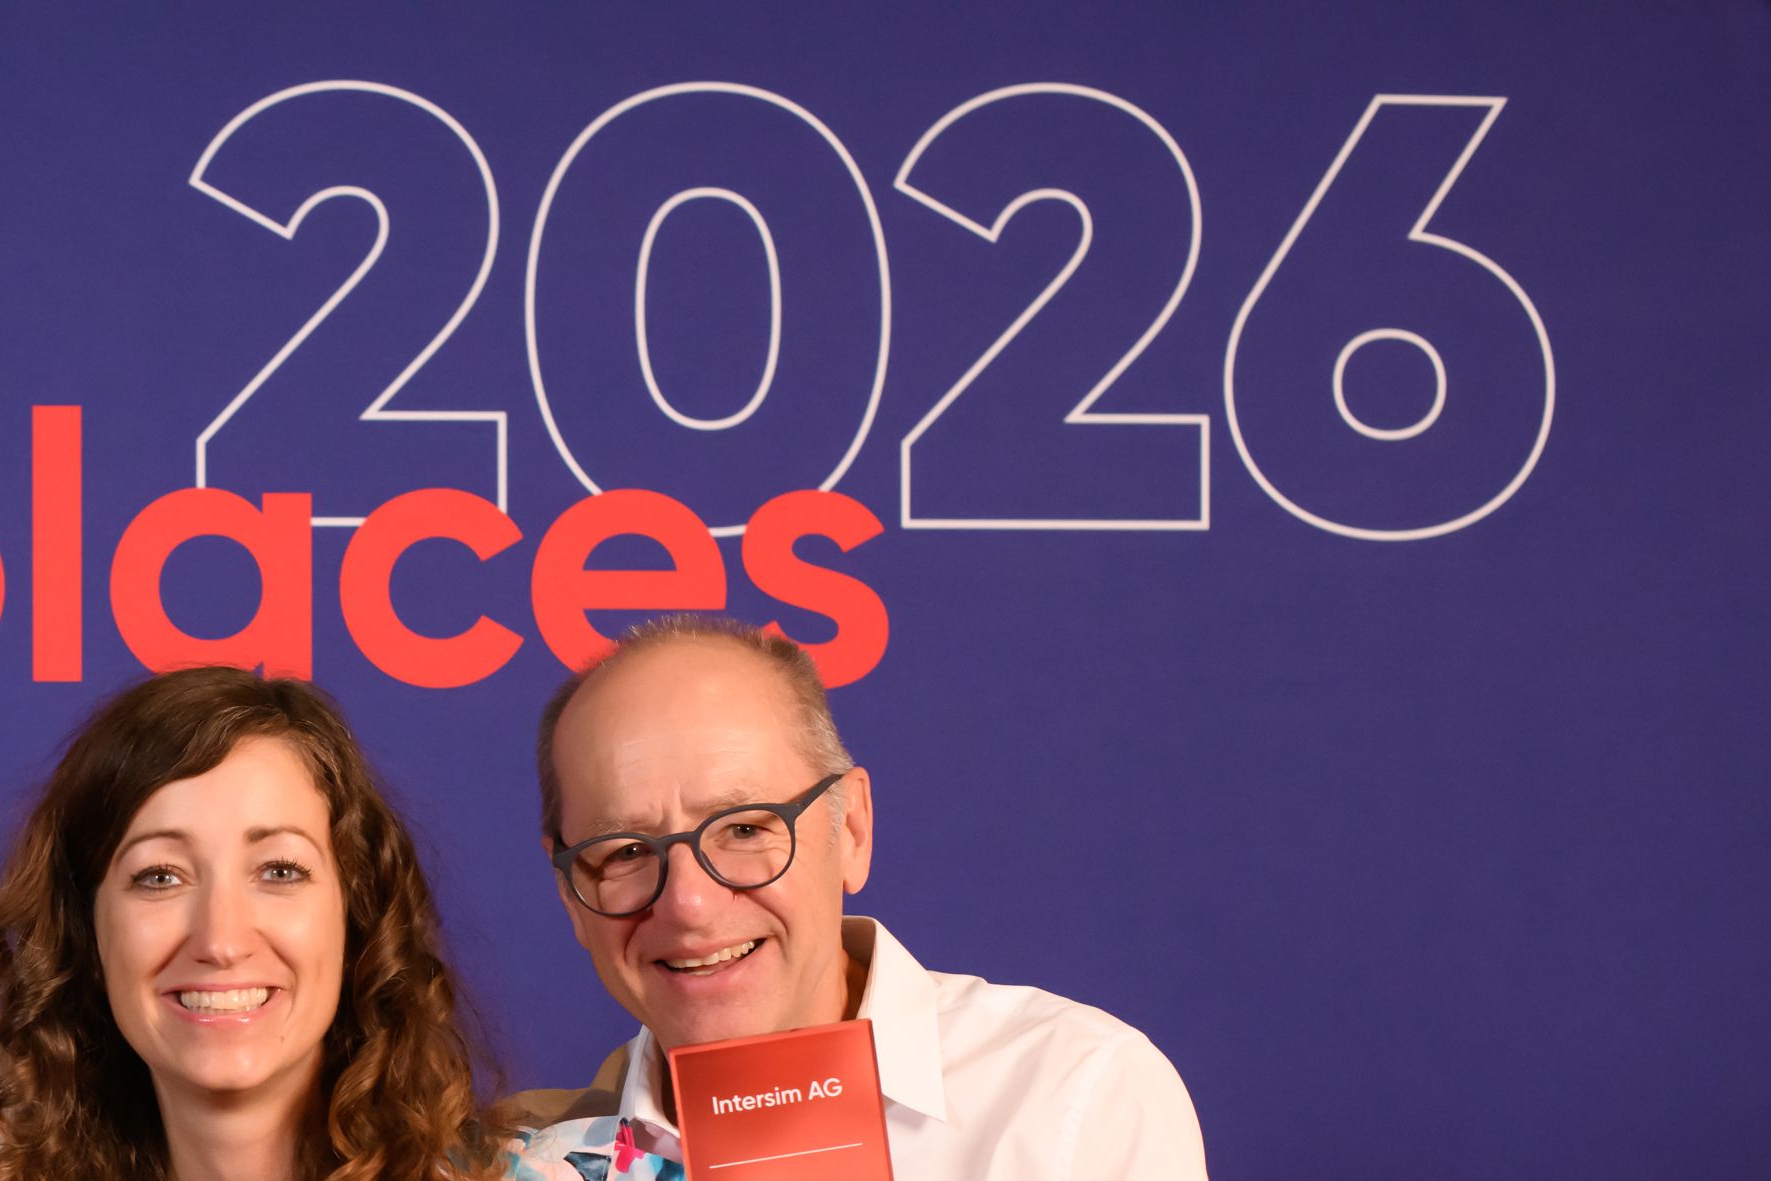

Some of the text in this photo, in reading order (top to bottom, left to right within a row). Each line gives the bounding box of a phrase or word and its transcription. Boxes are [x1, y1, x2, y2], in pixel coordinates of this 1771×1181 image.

[189, 80, 1556, 542] 2026
[712, 1078, 843, 1115] Intersim AG
